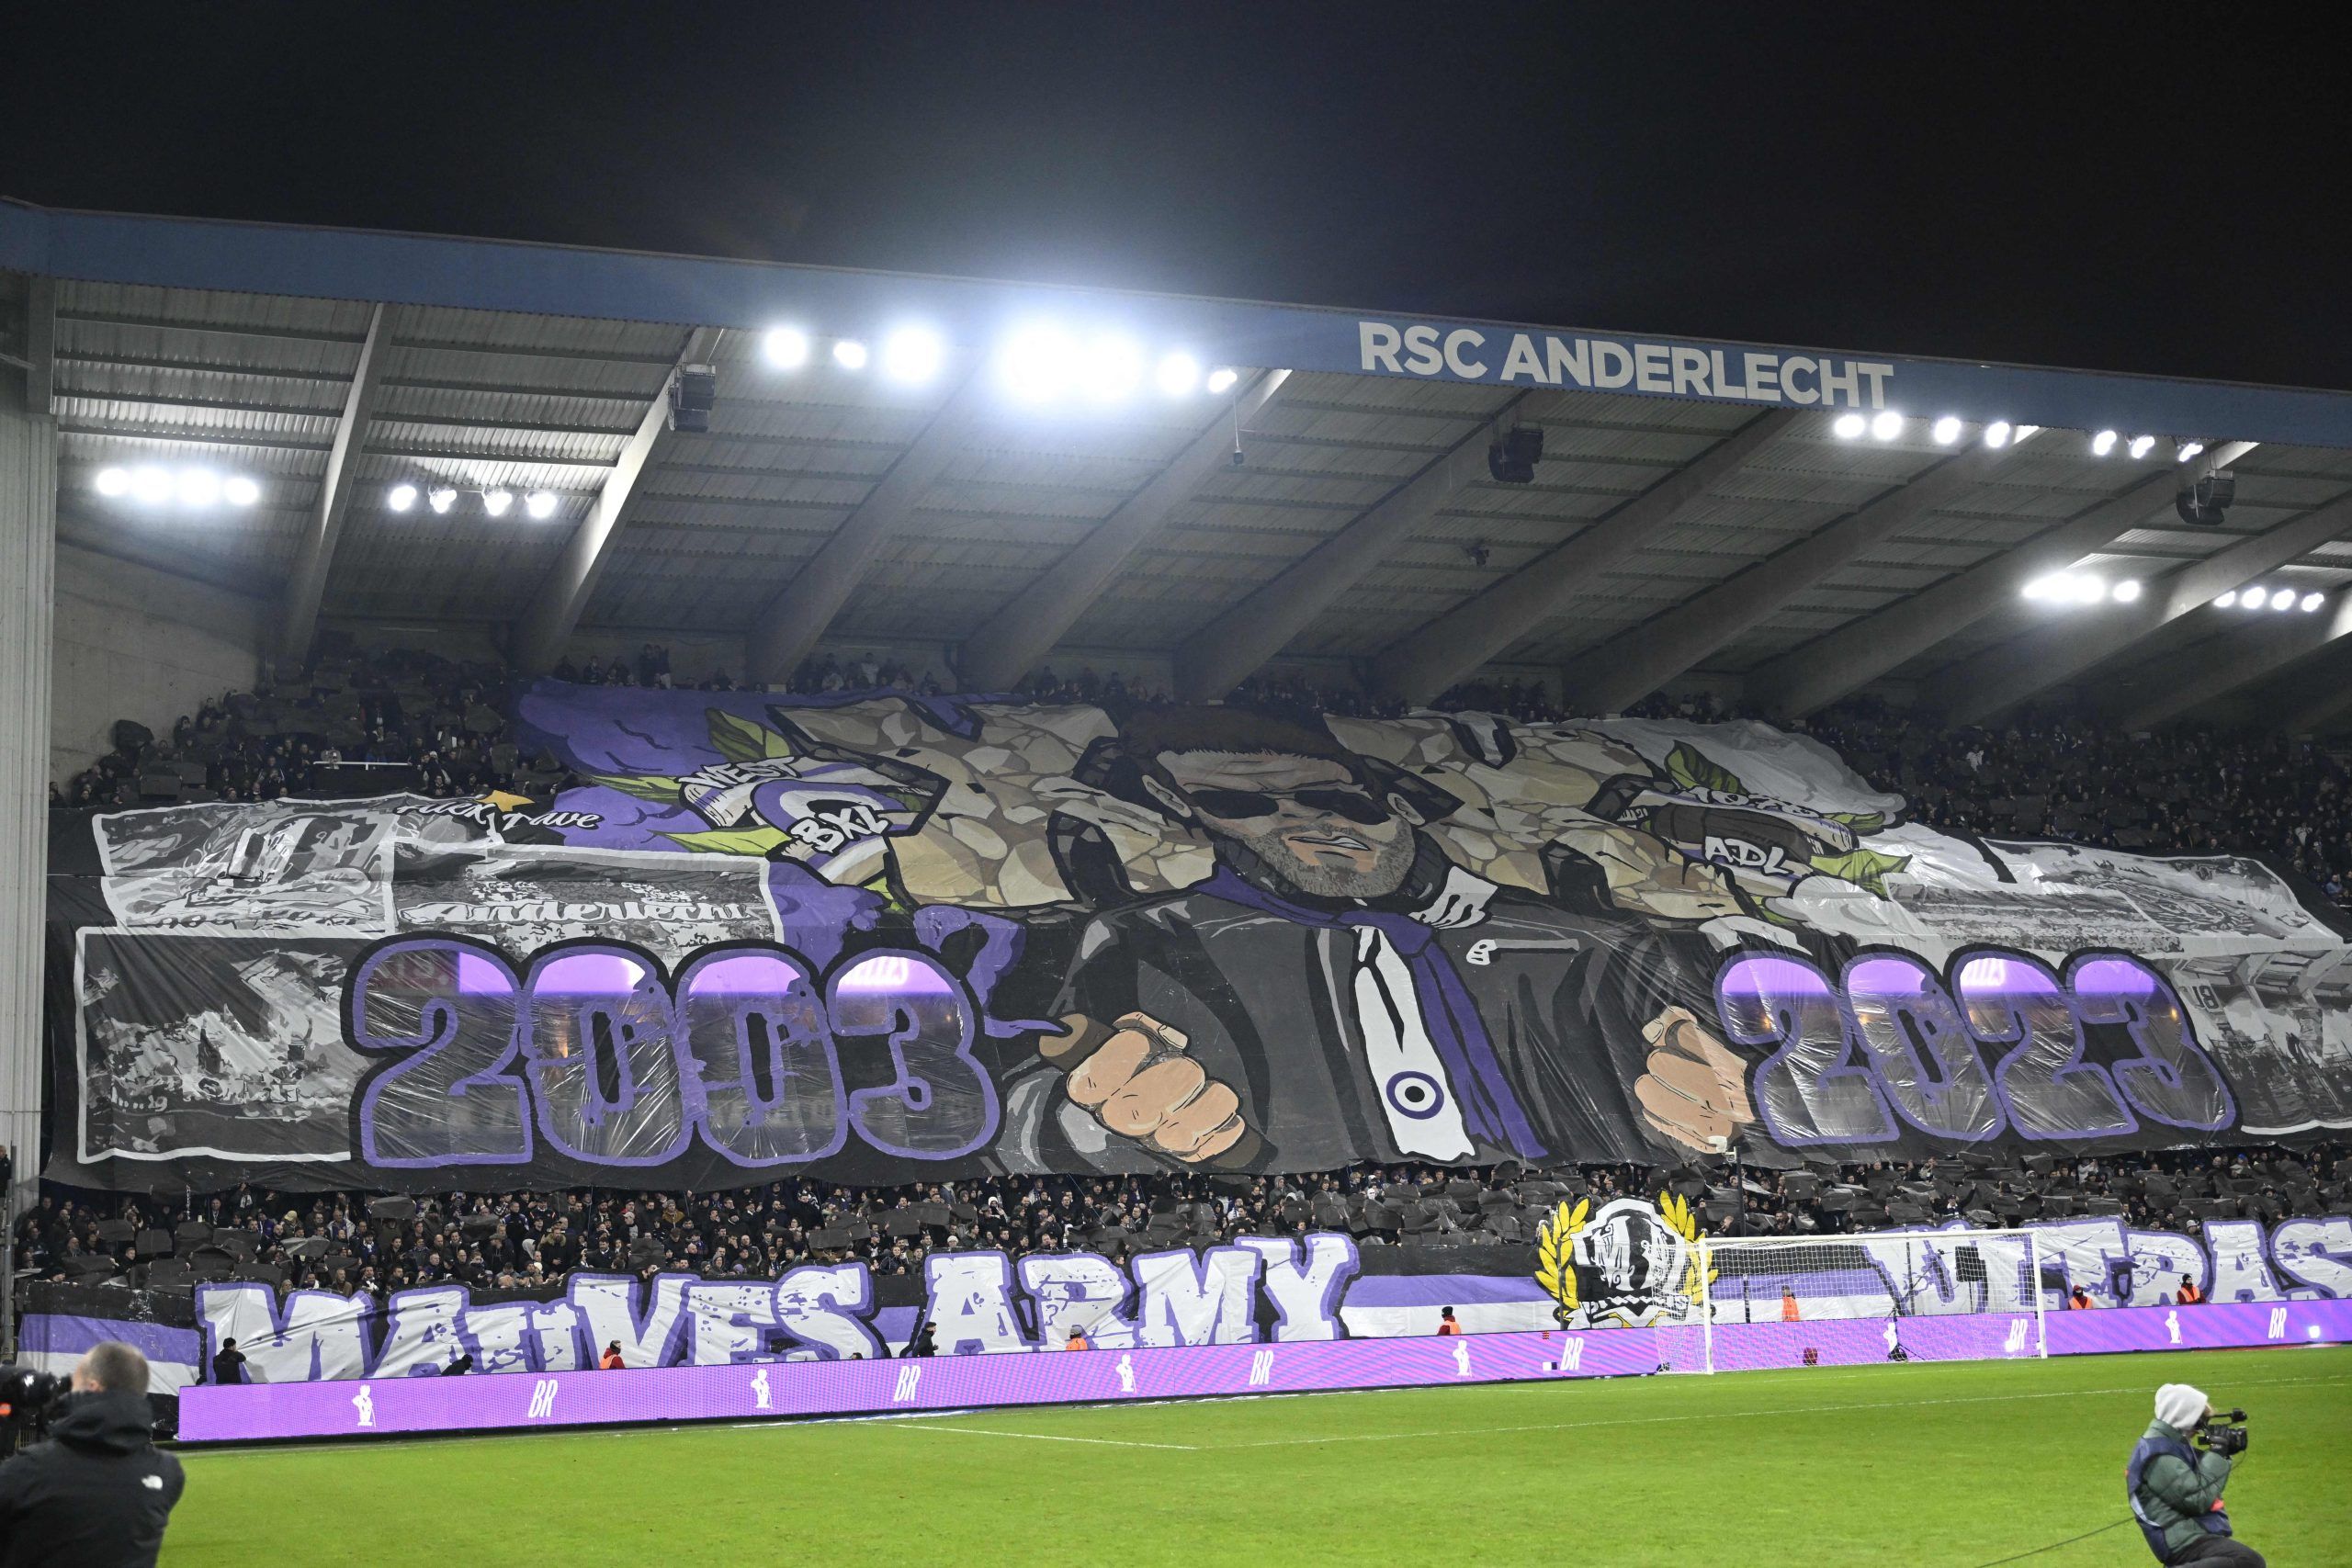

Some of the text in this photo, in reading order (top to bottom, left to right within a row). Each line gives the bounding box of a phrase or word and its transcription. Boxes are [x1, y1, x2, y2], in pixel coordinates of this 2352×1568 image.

[1359, 321, 1894, 409] RSC ANDERLECHT
[678, 756, 797, 789] WEST
[1705, 836, 1790, 874] ADL
[355, 940, 1000, 1167] 2003
[1714, 951, 2234, 1146] 2023
[925, 1233, 1360, 1352] ARMY
[2268, 1308, 2288, 1338] BR
[1250, 1350, 1273, 1386] BR
[1560, 1337, 1584, 1371] BR
[528, 1379, 557, 1418] BR
[893, 1365, 921, 1403] BR
